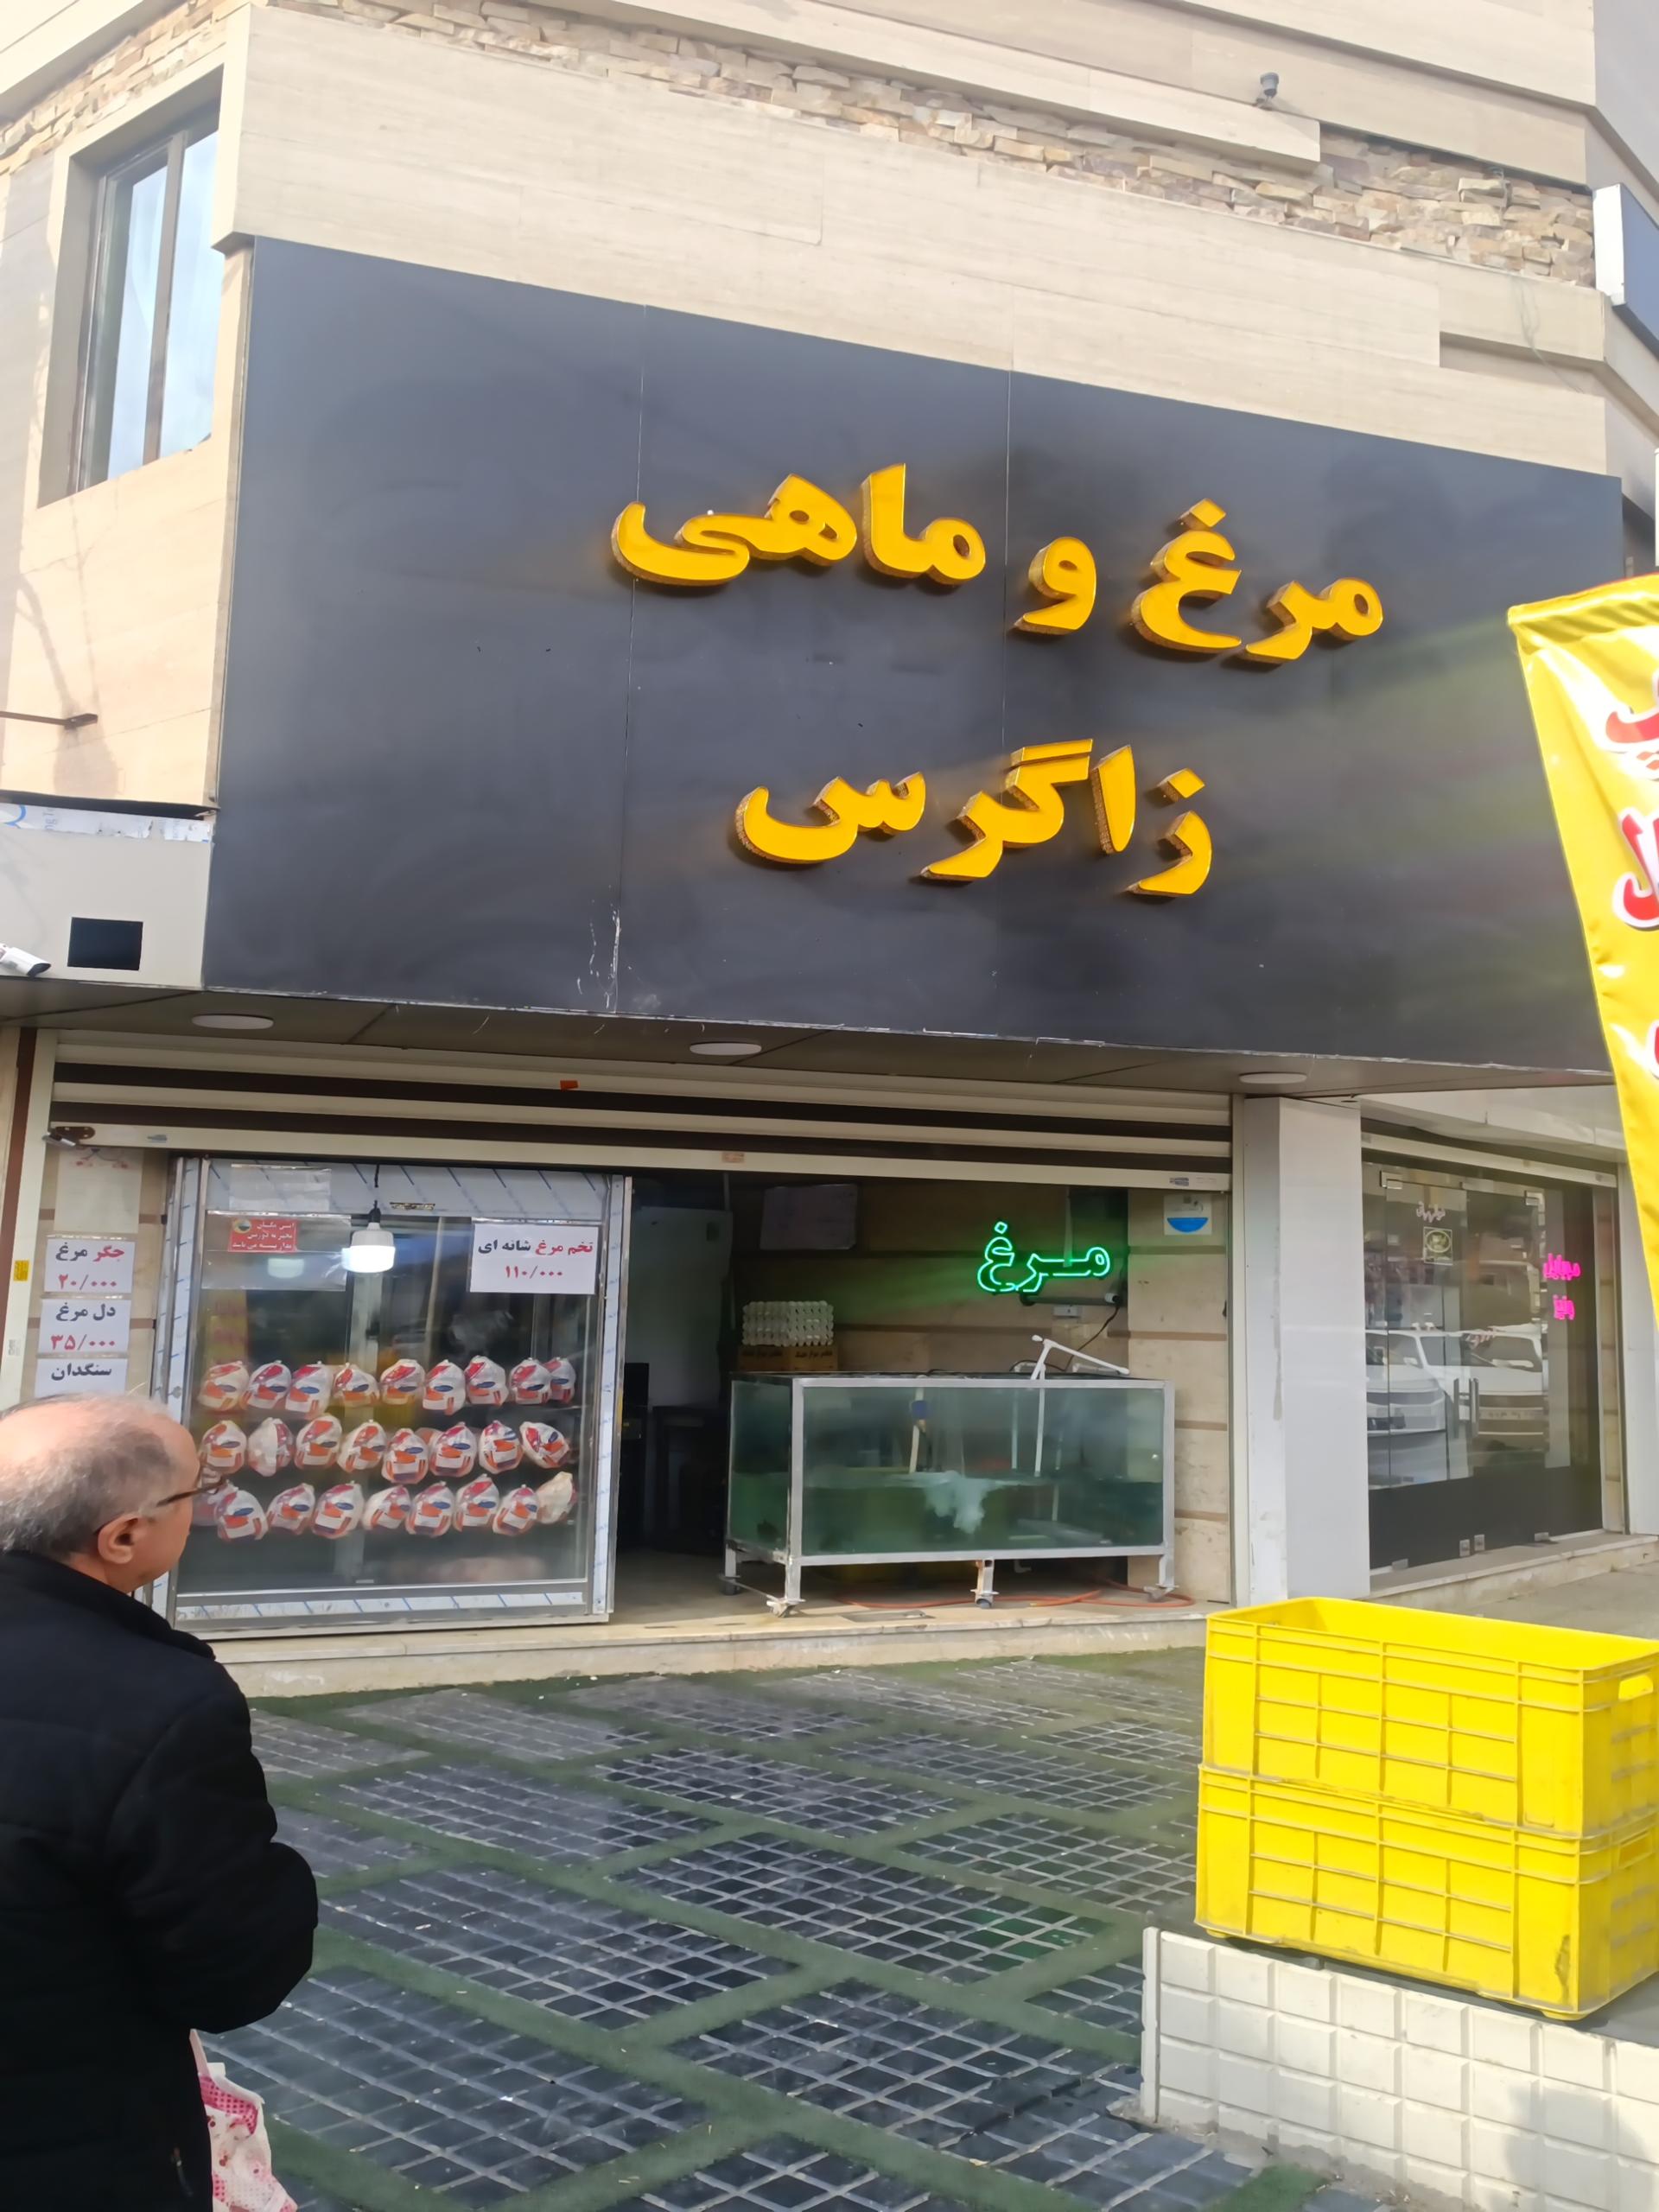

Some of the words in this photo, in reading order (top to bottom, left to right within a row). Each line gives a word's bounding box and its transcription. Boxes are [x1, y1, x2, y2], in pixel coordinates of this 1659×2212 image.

[611, 463, 986, 587] ماهی
[1014, 537, 1097, 635] و
[1129, 498, 1384, 664] مرغ
[734, 738, 1212, 898] زاگرس
[55, 1242, 88, 1262] مرغ
[92, 1244, 125, 1262] جگر
[478, 1239, 499, 1254] ای
[501, 1239, 531, 1252] شانه
[535, 1240, 563, 1255] مرغ
[567, 1241, 594, 1255] تخم
[976, 1221, 1110, 1293] مرغ
[505, 1265, 563, 1279] ۱۱۰/۰۰۰
[58, 1274, 118, 1290] ۲۰/۰۰۰
[55, 1302, 88, 1322] مرغ
[92, 1303, 117, 1321] دل
[50, 1334, 116, 1351] ۳۵/۰۰۰
[51, 1363, 112, 1381] سنگدان
